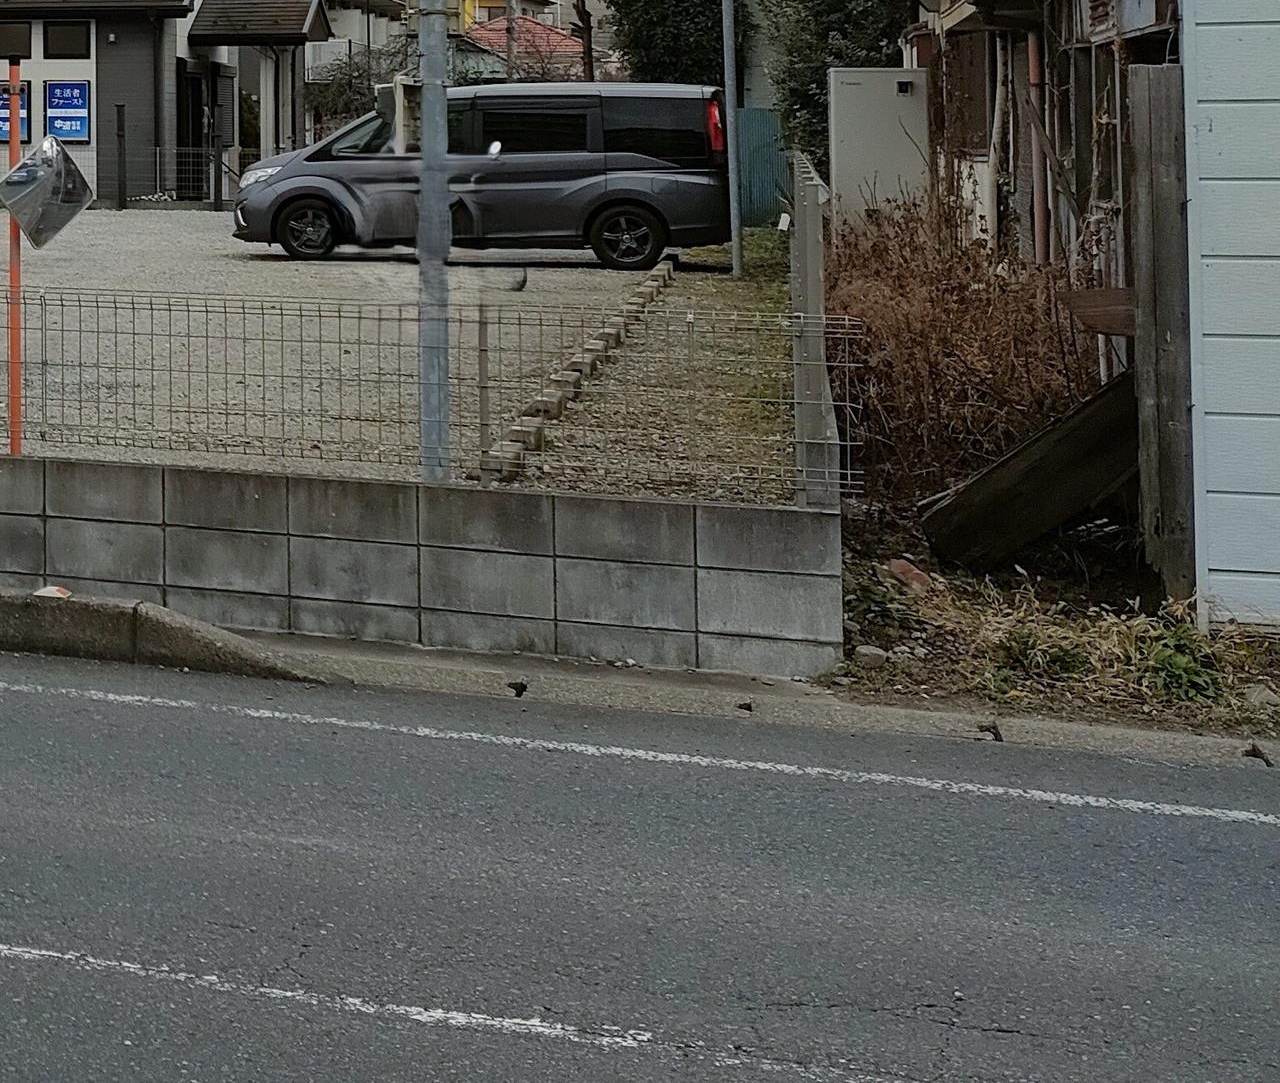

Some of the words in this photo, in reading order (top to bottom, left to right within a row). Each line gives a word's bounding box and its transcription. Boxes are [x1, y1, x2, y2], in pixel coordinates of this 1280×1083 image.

[54, 88, 80, 97] 生活者
[51, 98, 83, 106] ファースト
